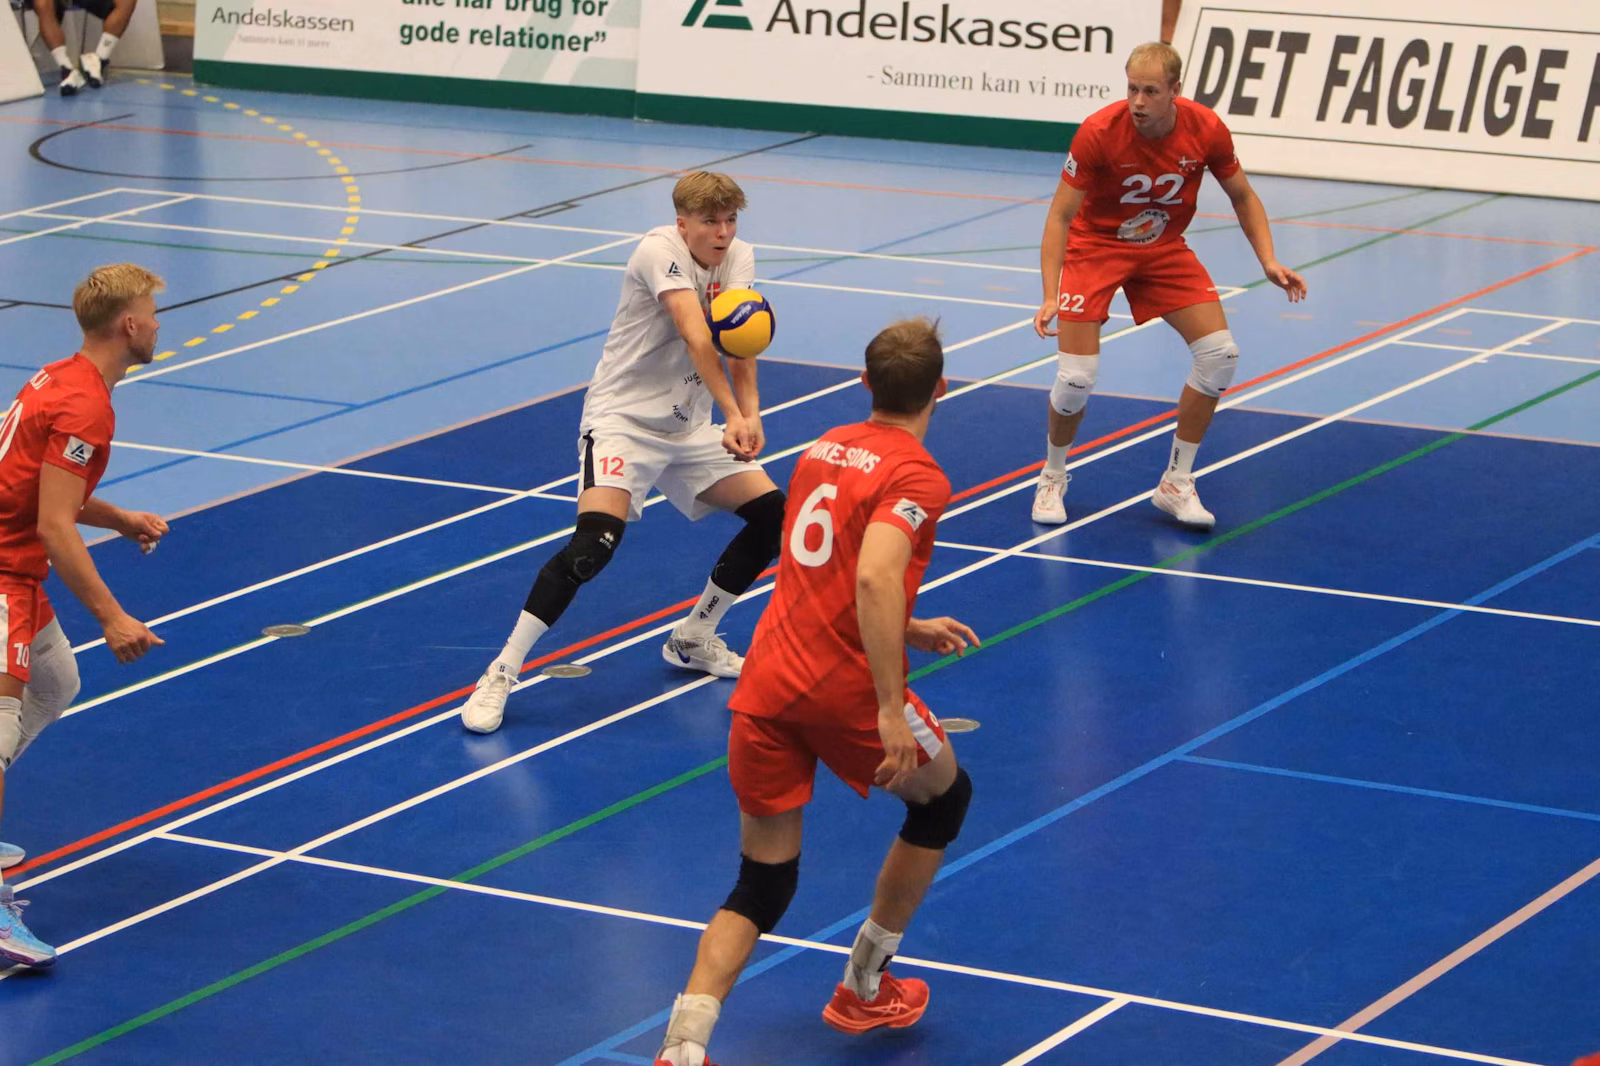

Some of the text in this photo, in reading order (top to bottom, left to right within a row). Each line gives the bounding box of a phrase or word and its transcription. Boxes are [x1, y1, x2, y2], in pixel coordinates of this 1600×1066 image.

[211, 6, 354, 32] Andelskassen
[572, 0, 608, 16] for
[400, 21, 459, 45] gode
[765, 0, 1114, 53] Andelskassen
[881, 65, 973, 90] Sammen
[981, 71, 1020, 93] kan
[1028, 76, 1046, 95] vi
[1053, 82, 1111, 99] mere
[1194, 27, 1311, 118] DET
[1315, 35, 1569, 139] FAGLIGE
[1119, 173, 1185, 205] 22
[1060, 292, 1085, 313] 22
[599, 456, 625, 477] 12
[790, 483, 838, 567] 6
[13, 642, 30, 668] 10
